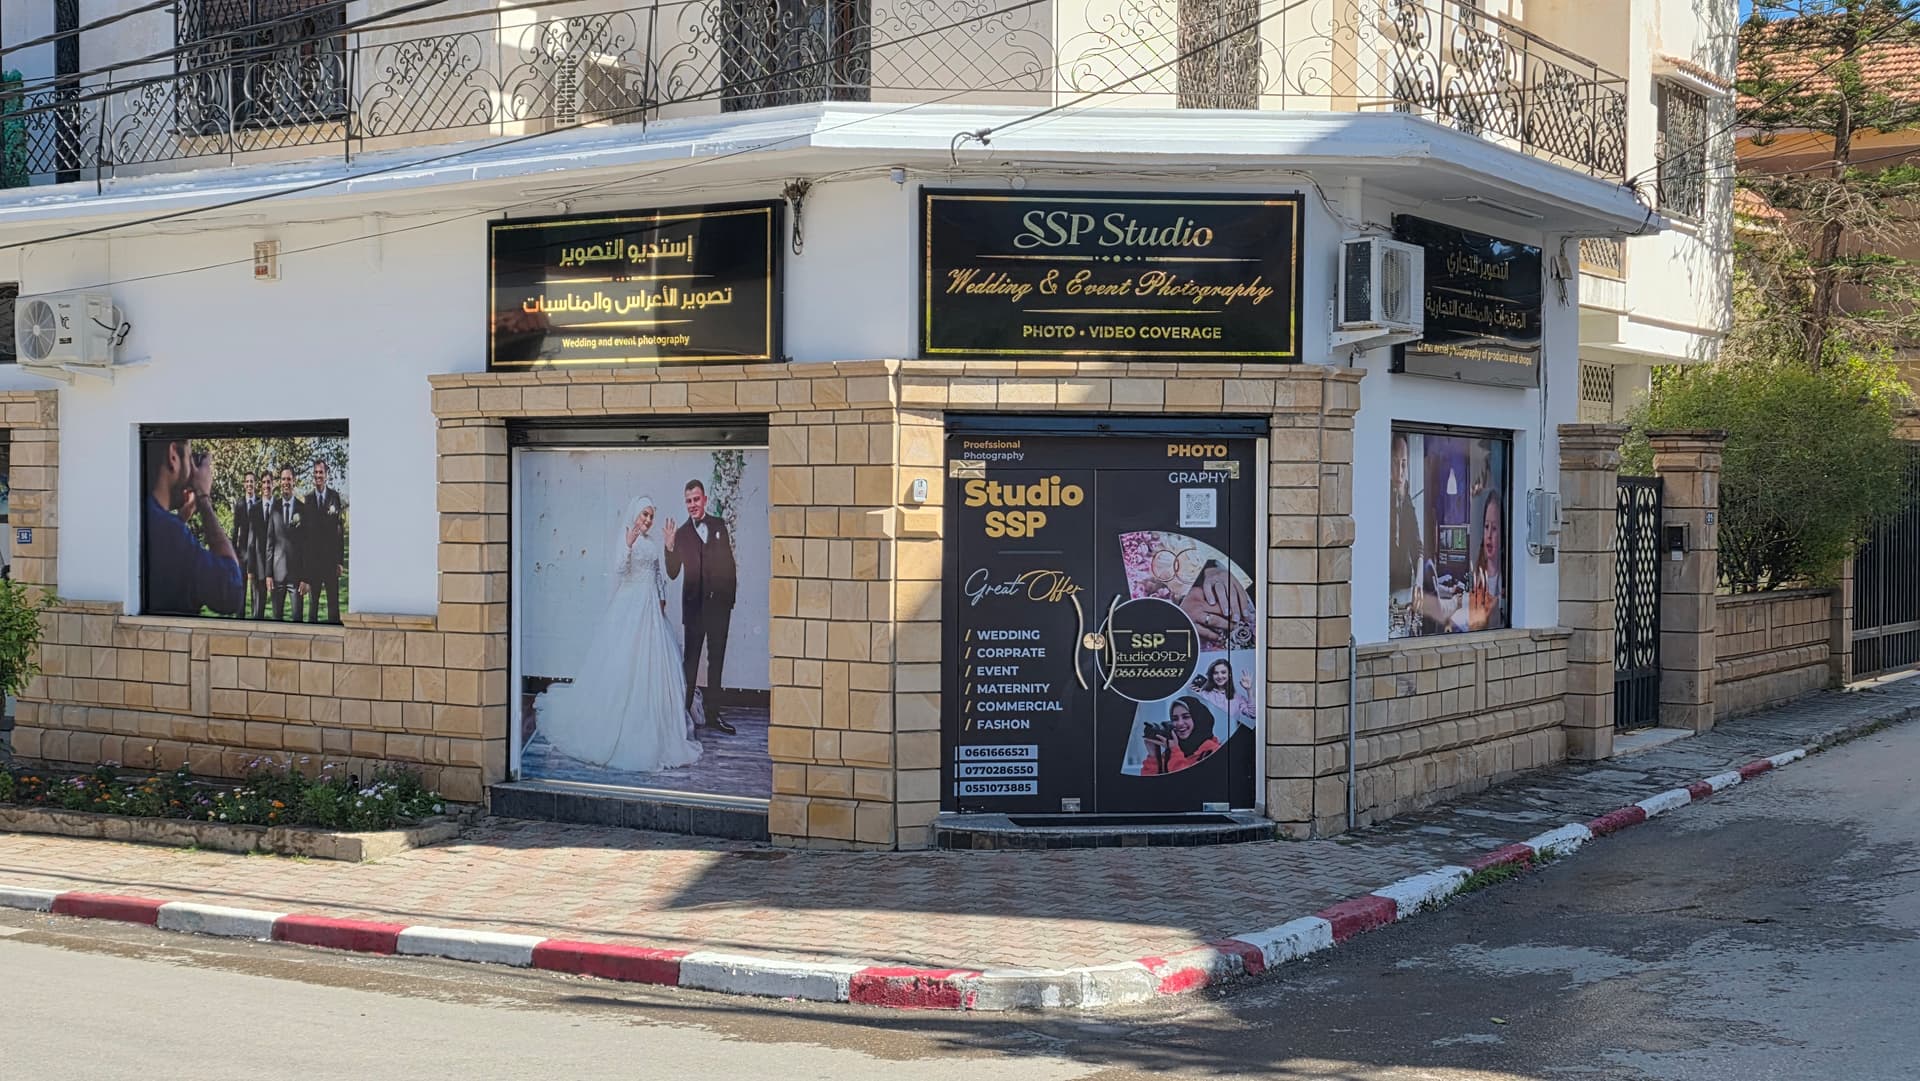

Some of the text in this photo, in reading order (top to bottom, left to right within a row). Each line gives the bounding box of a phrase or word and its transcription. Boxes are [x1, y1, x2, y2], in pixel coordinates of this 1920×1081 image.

[1013, 210, 1214, 249] SSP Studio
[559, 234, 693, 267] إستديو التصوير
[945, 268, 1274, 306] Wedding & Event Photography
[522, 285, 732, 316] تصوير الأعراس والمناسبات
[1022, 324, 1222, 340] PHOTO VIDEO COVERAGE
[562, 334, 690, 349] Wedding and event photography
[963, 440, 1021, 449] Proefssional
[963, 451, 1025, 461] Photography
[1167, 444, 1228, 458] PHOTO
[1168, 472, 1229, 484] GRAPHY
[964, 475, 1085, 508] Studio
[985, 510, 1047, 538] SSP
[964, 568, 1085, 607] Great Offer
[976, 629, 1041, 641] WEDDING
[1130, 633, 1166, 649] SSP
[976, 647, 1046, 659] CORPRATE
[976, 666, 1019, 677] EVENT
[976, 683, 1050, 694] MATERNITY
[976, 700, 1063, 712] COMMERCIAL
[976, 719, 1030, 730] FASHON
[964, 747, 1029, 757] 0661666521
[964, 765, 1034, 776] 0770286550
[964, 783, 1032, 793] 0551073885
